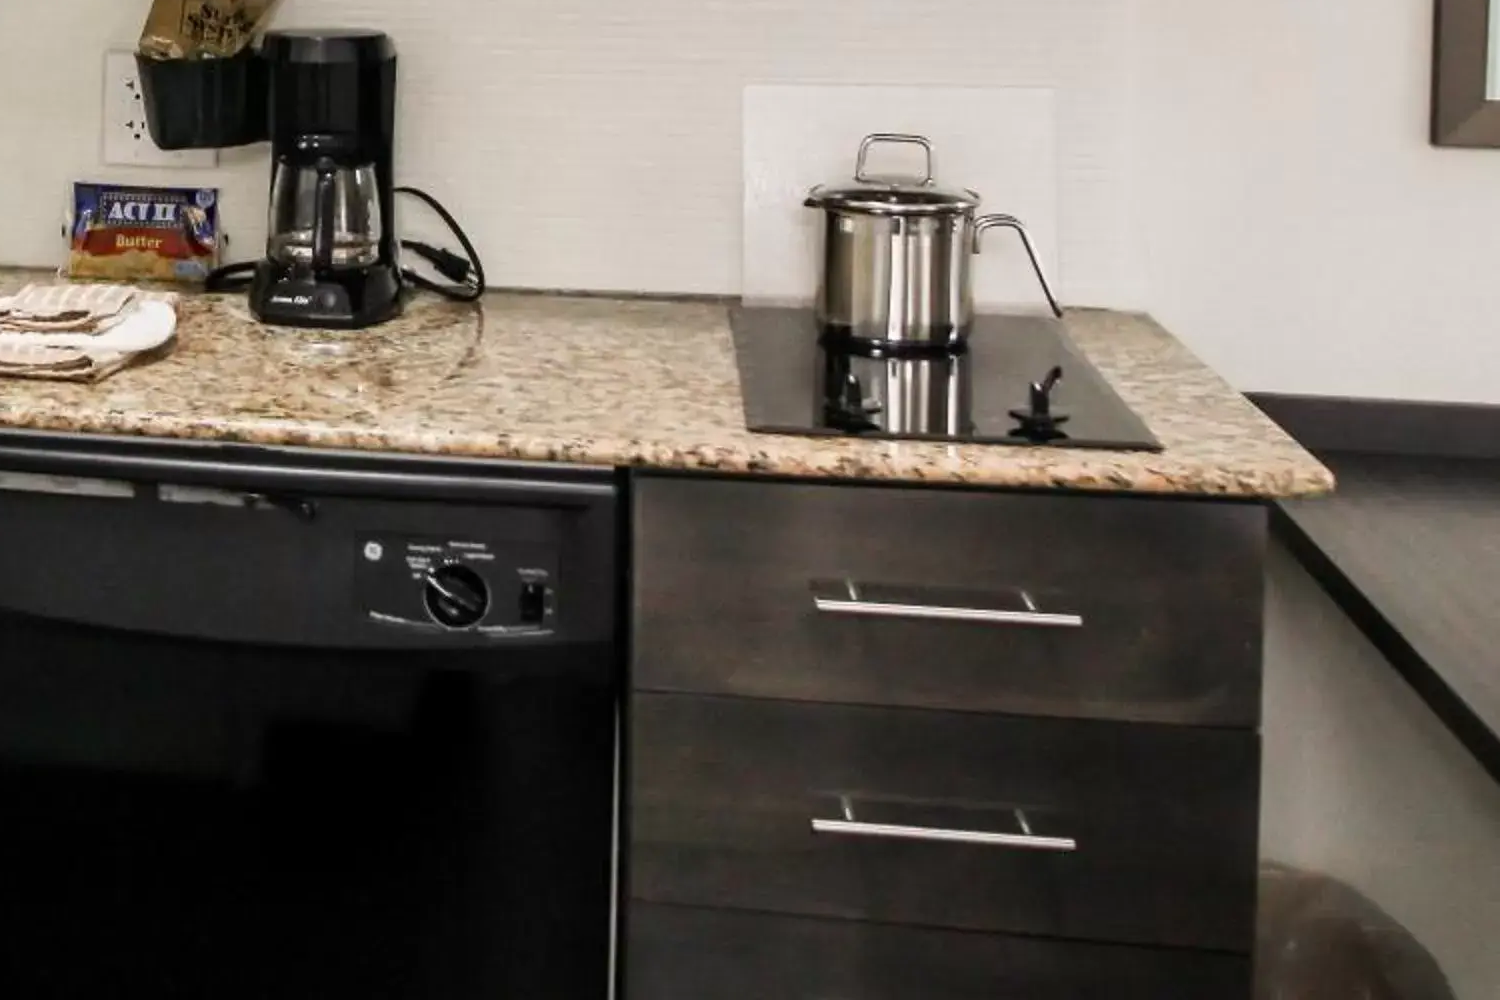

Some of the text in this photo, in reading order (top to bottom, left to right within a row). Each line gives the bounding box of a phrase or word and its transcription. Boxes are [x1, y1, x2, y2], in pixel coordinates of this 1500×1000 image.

[108, 201, 176, 221] ACT II
[115, 233, 163, 249] Butter
